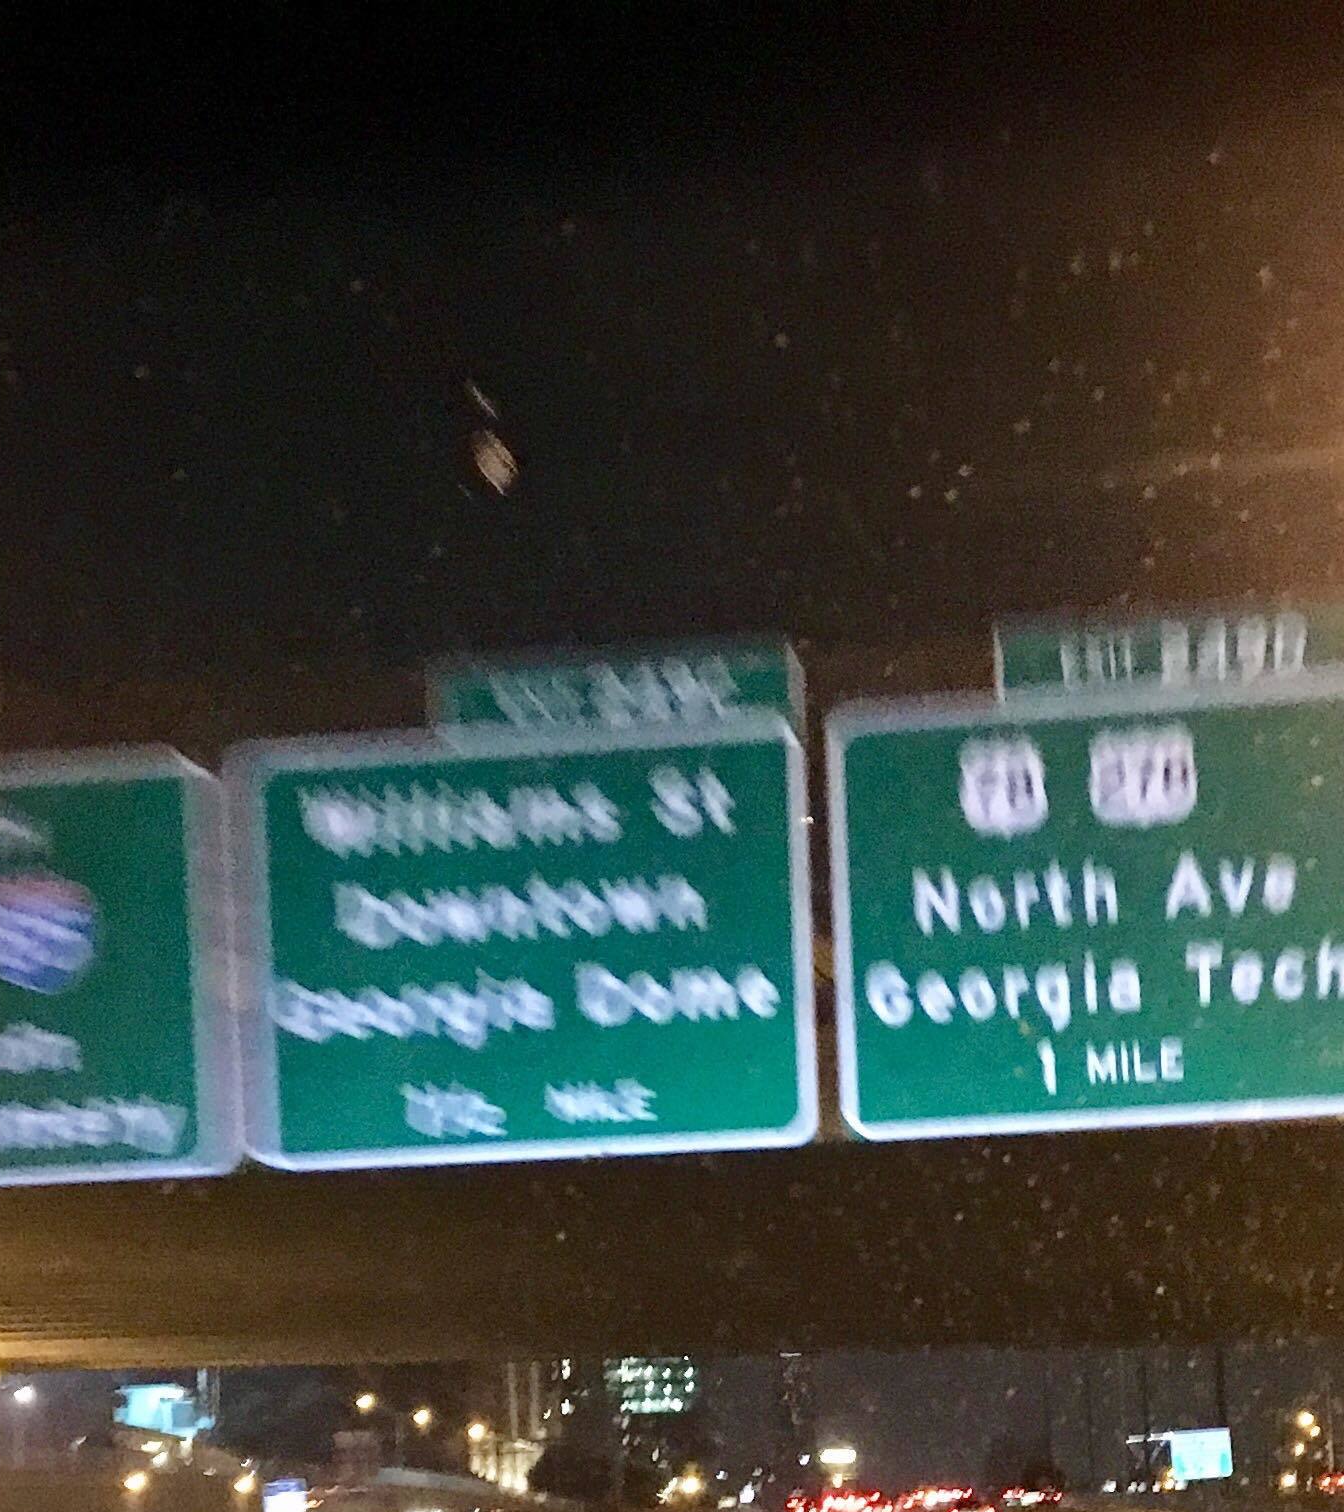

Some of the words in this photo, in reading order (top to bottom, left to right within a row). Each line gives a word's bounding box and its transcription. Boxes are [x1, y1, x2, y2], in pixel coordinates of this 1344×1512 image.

[912, 858, 1119, 936] North
[1164, 850, 1298, 920] Ave
[864, 951, 1143, 1031] Georgia
[1036, 1039, 1057, 1097] 1
[1086, 1037, 1185, 1085] MILE
